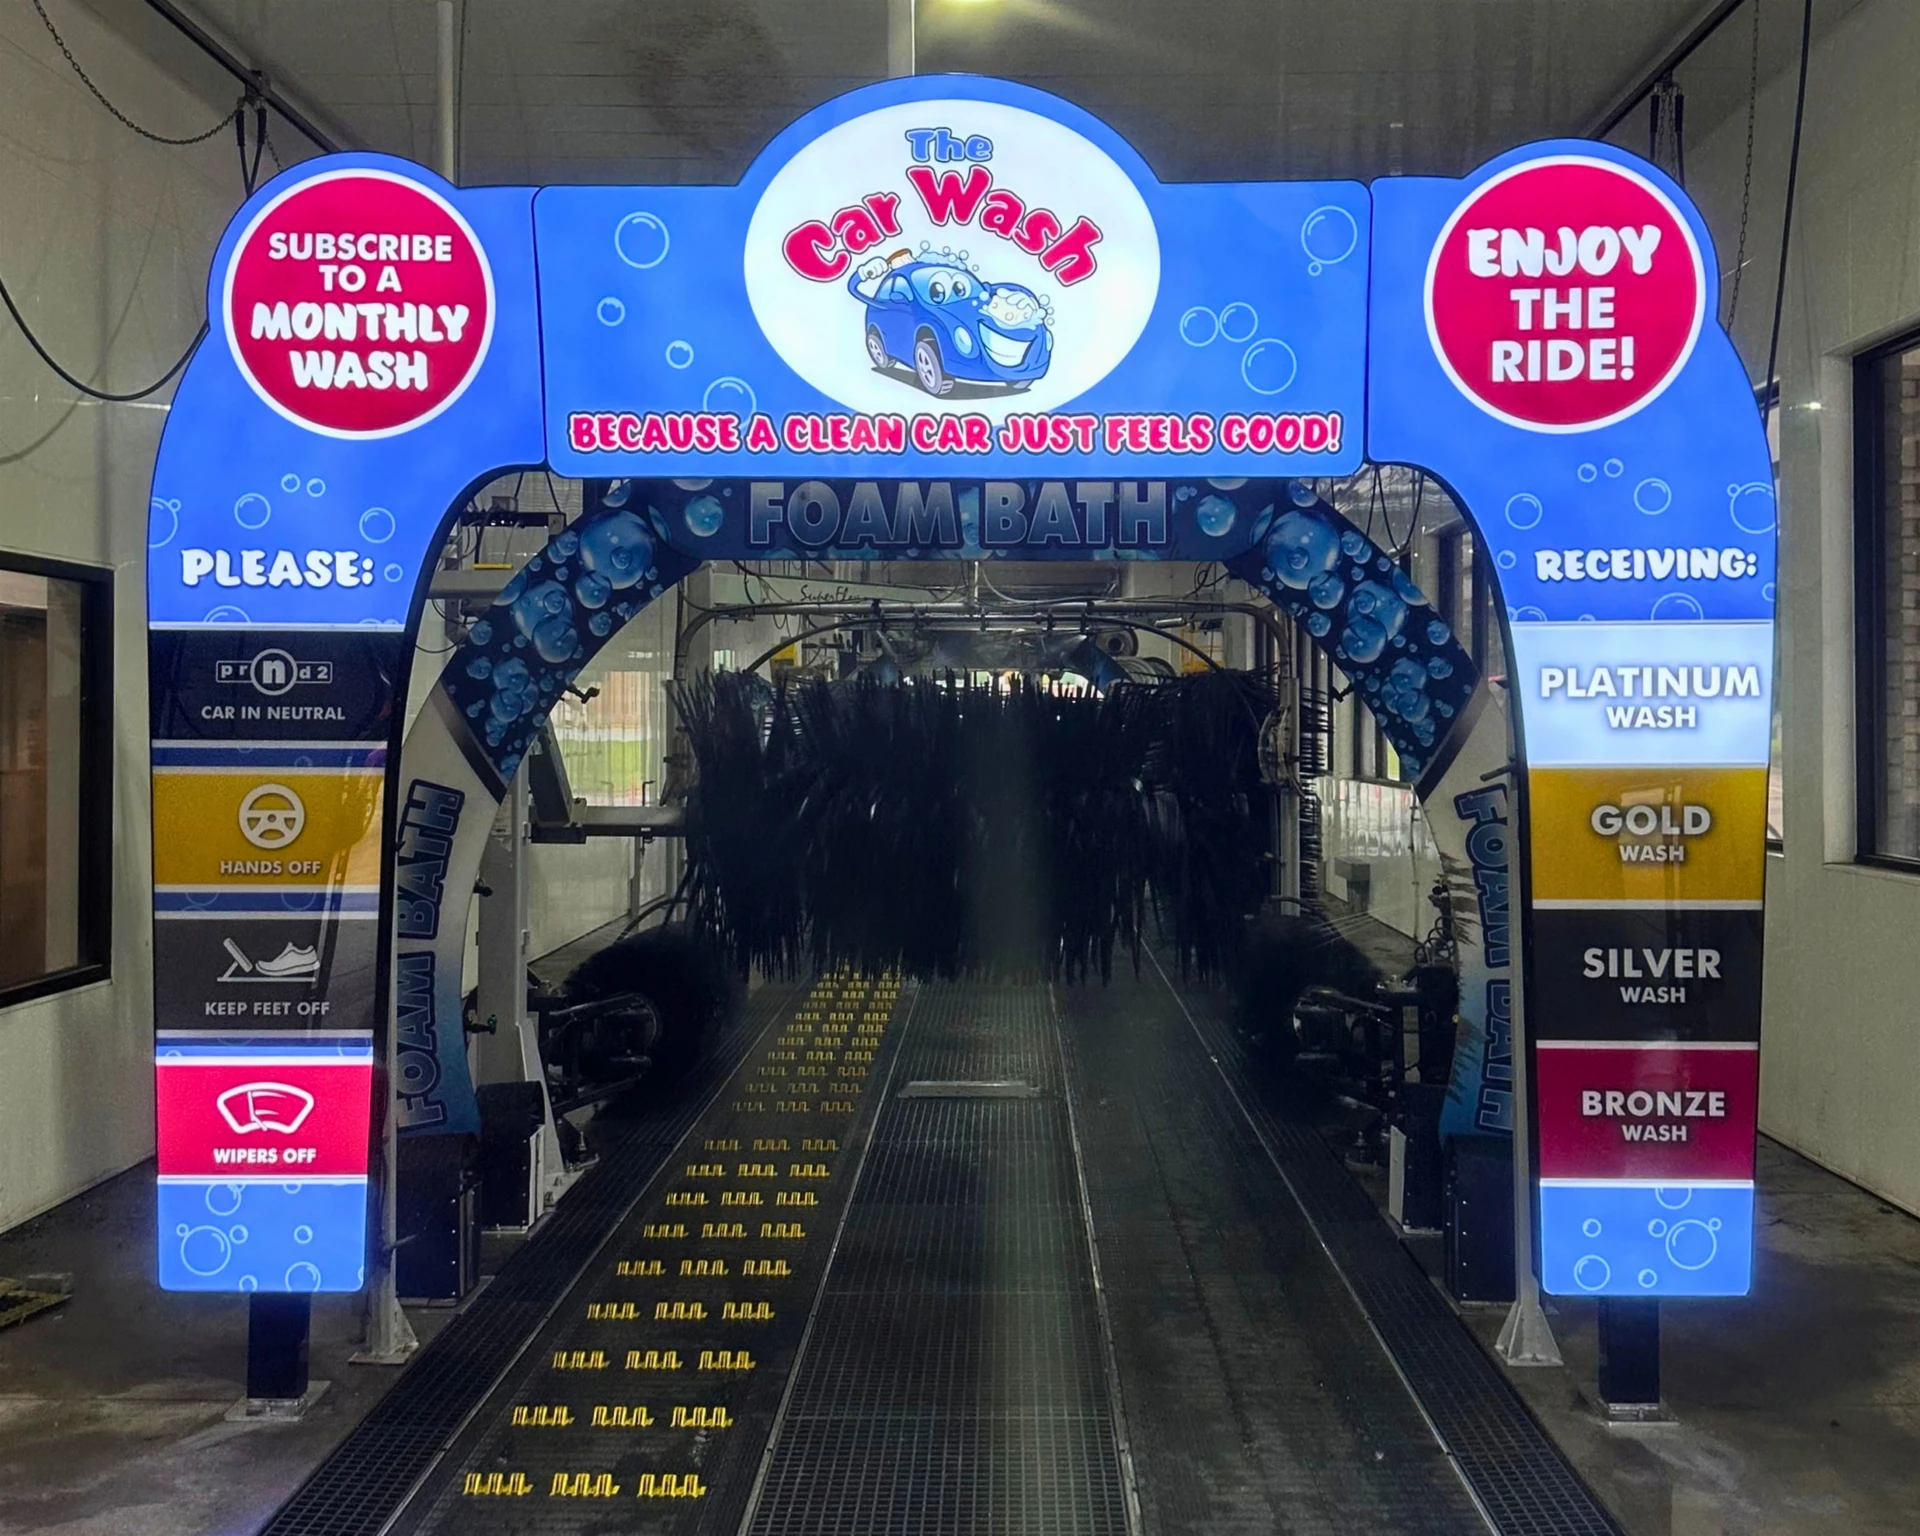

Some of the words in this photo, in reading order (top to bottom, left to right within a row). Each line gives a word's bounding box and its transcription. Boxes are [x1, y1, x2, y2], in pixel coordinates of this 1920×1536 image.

[907, 128, 992, 161] The
[784, 193, 901, 281] Car
[907, 166, 1101, 284] Wash
[268, 232, 453, 262] SUBSCRIBE
[1466, 224, 1662, 278] ENJOY
[318, 264, 367, 292] TO
[375, 264, 403, 293] A
[250, 301, 470, 343] MONTHLY
[1509, 286, 1616, 330] THE
[288, 350, 429, 392] WASH
[1491, 336, 1635, 383] RIDE!
[570, 413, 740, 453] BECAUSE
[745, 415, 779, 453] A
[783, 415, 907, 453] CLEAN
[910, 415, 993, 453] CAR
[1000, 415, 1098, 453] JUST
[1103, 415, 1214, 453] FEELS
[1220, 415, 1343, 453] GOOD!
[749, 481, 958, 545] FOAM
[984, 481, 1167, 544] BATH
[181, 548, 375, 587] PLEASE:
[1534, 546, 1758, 581] RECEIVING:
[1540, 665, 1760, 698] PLATINUM
[200, 705, 236, 721] CAR
[241, 706, 261, 721] IN
[267, 706, 346, 721] NEUTRAL
[1605, 705, 1697, 729] WASH
[1590, 803, 1712, 836] GOLD
[219, 859, 282, 875] HANDS
[288, 860, 321, 875] OFF
[397, 784, 461, 936] BATH
[1618, 843, 1685, 863] WASH
[1582, 947, 1722, 979] SILVER
[205, 1001, 248, 1017] KEEP
[253, 1001, 290, 1017] FEET
[296, 1001, 330, 1017] OFF
[1619, 986, 1687, 1005] WASH
[397, 955, 444, 1128] FOAM
[1581, 1090, 1726, 1118] BRONZE
[1621, 1123, 1688, 1142] WASH
[212, 1147, 276, 1165] WIPERS
[282, 1147, 317, 1165] OFF
